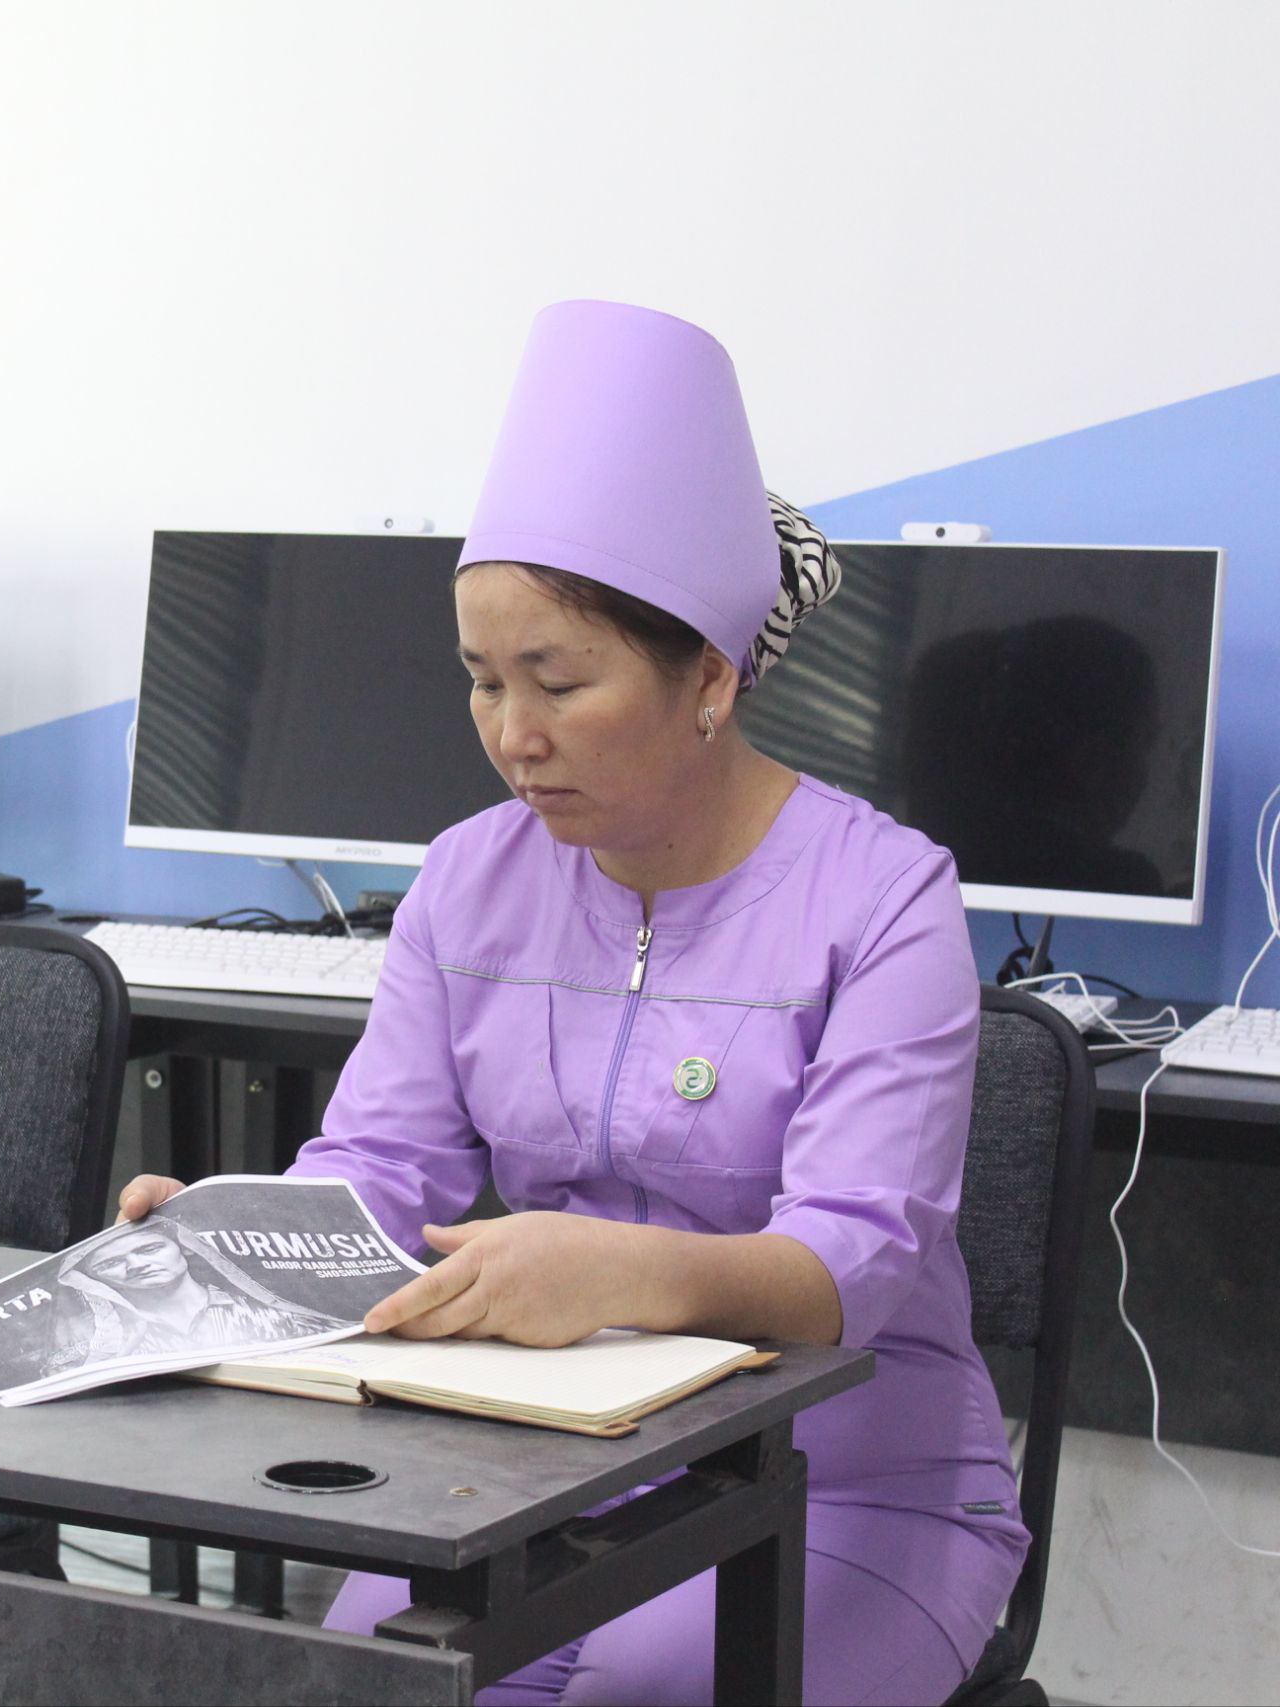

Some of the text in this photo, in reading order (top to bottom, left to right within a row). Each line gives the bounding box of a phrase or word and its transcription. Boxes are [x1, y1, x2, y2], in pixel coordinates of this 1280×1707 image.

[195, 1230, 388, 1259] TURMUSH
[261, 1259, 302, 1271] QAROR
[303, 1260, 342, 1271] QABUL
